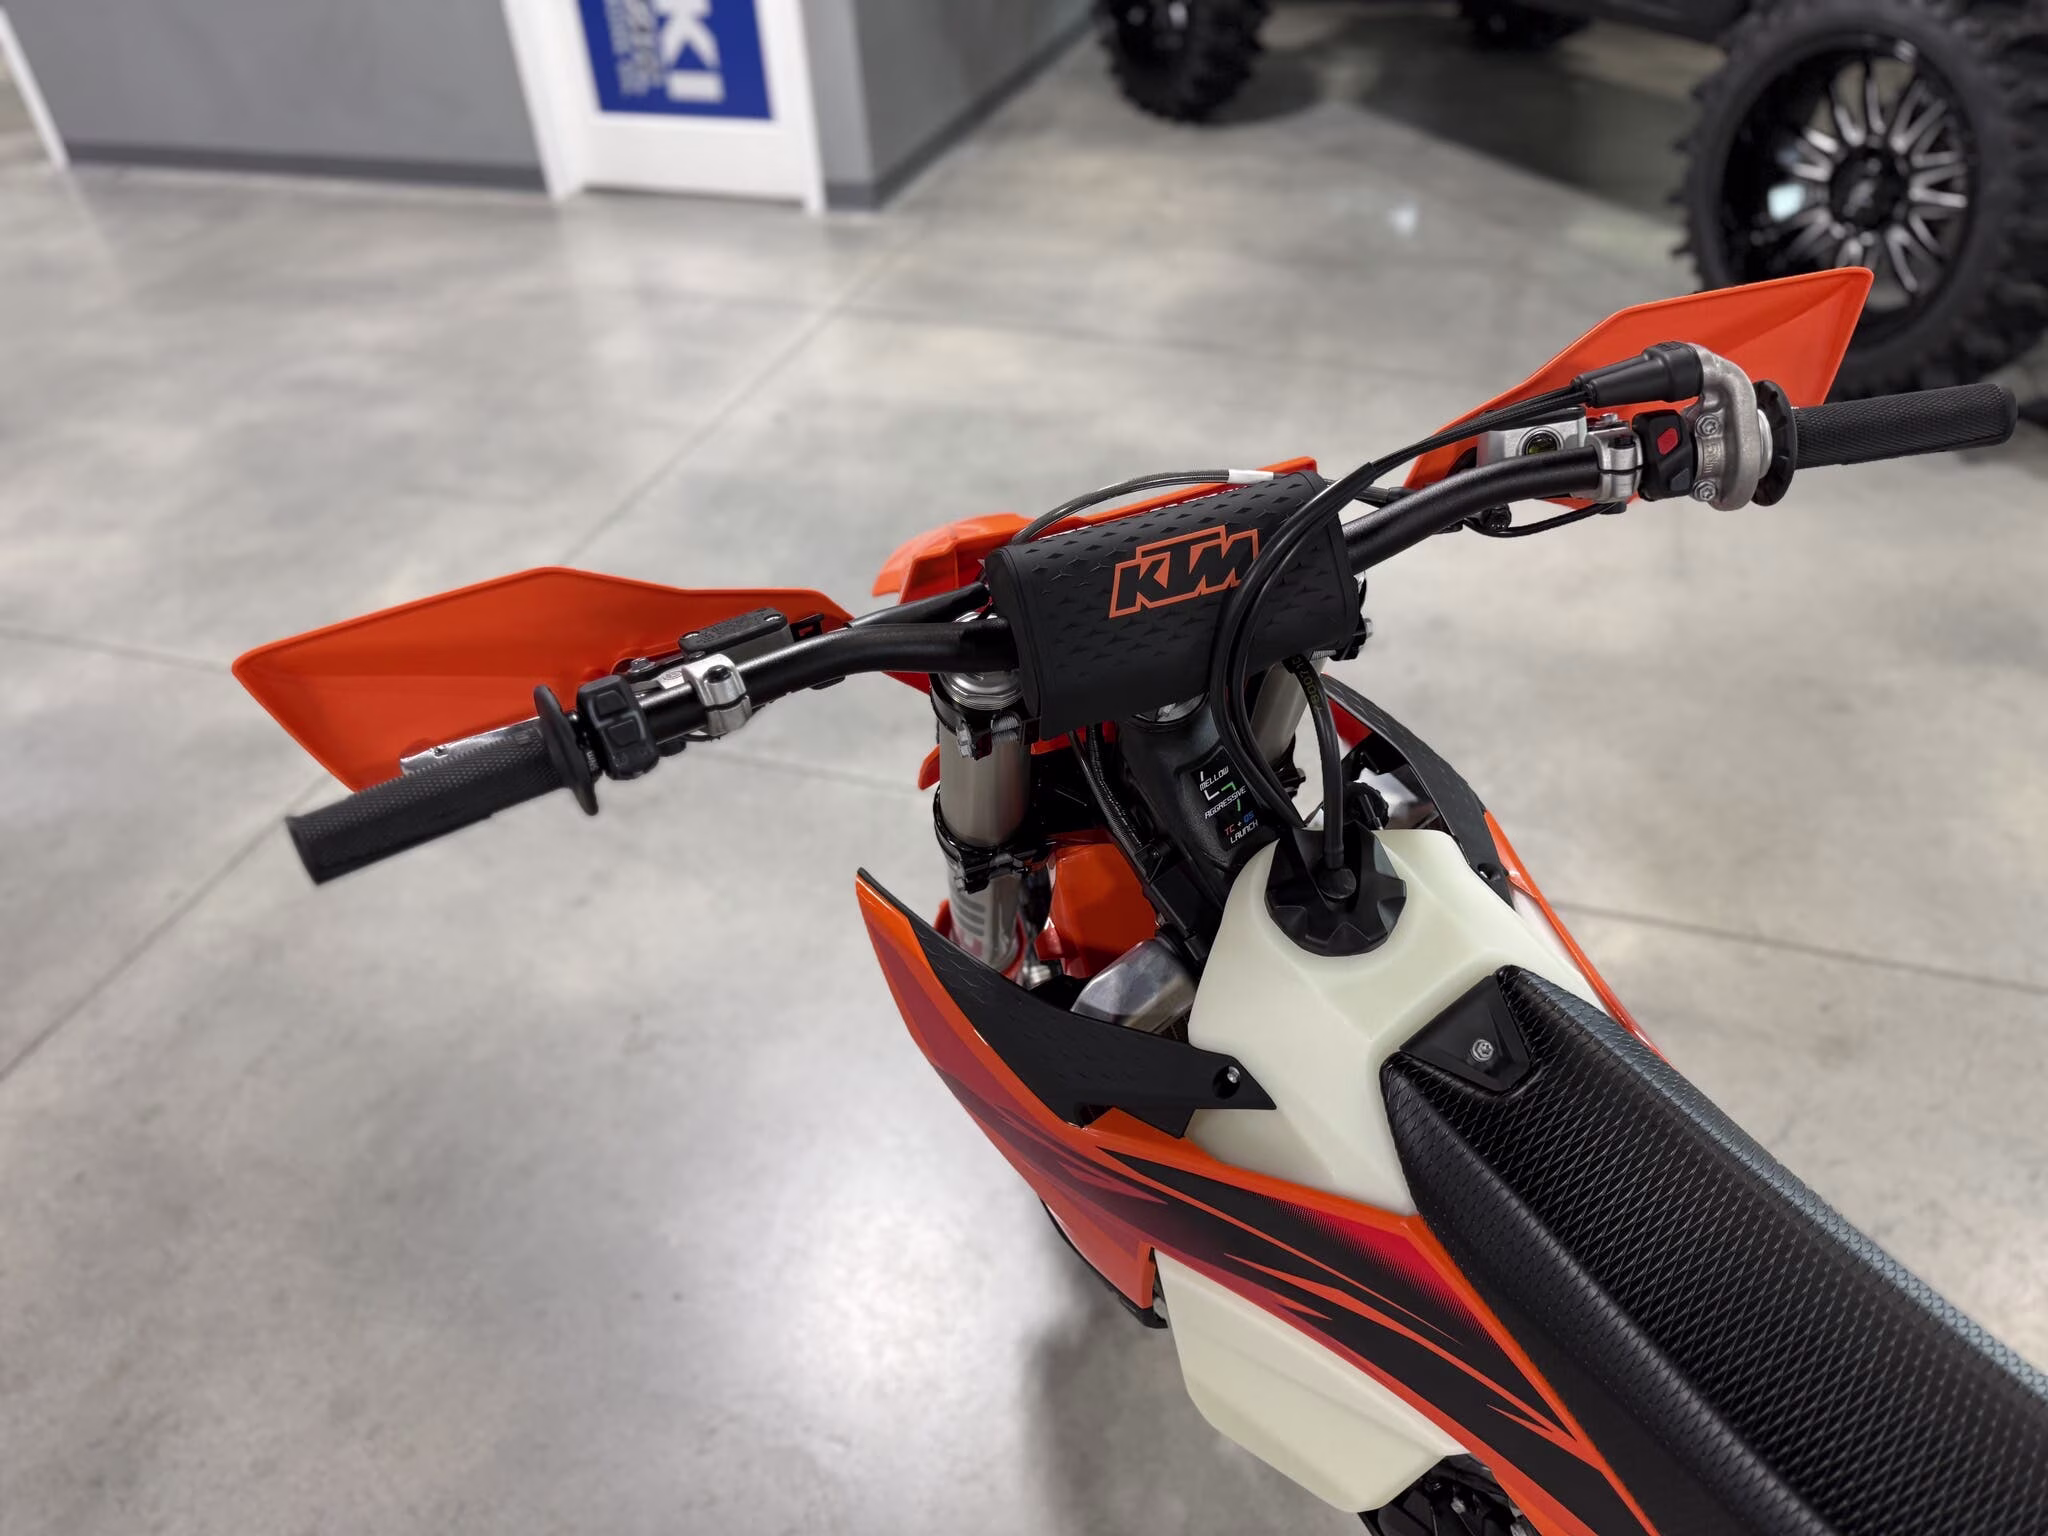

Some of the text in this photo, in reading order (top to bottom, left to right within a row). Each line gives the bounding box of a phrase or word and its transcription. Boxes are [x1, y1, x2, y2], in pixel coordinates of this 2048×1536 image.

[1109, 524, 1260, 619] KTM
[1199, 765, 1229, 791] MELLOW
[1204, 785, 1247, 819] AGGRESSIVE
[1230, 819, 1258, 844] LAUNCH
